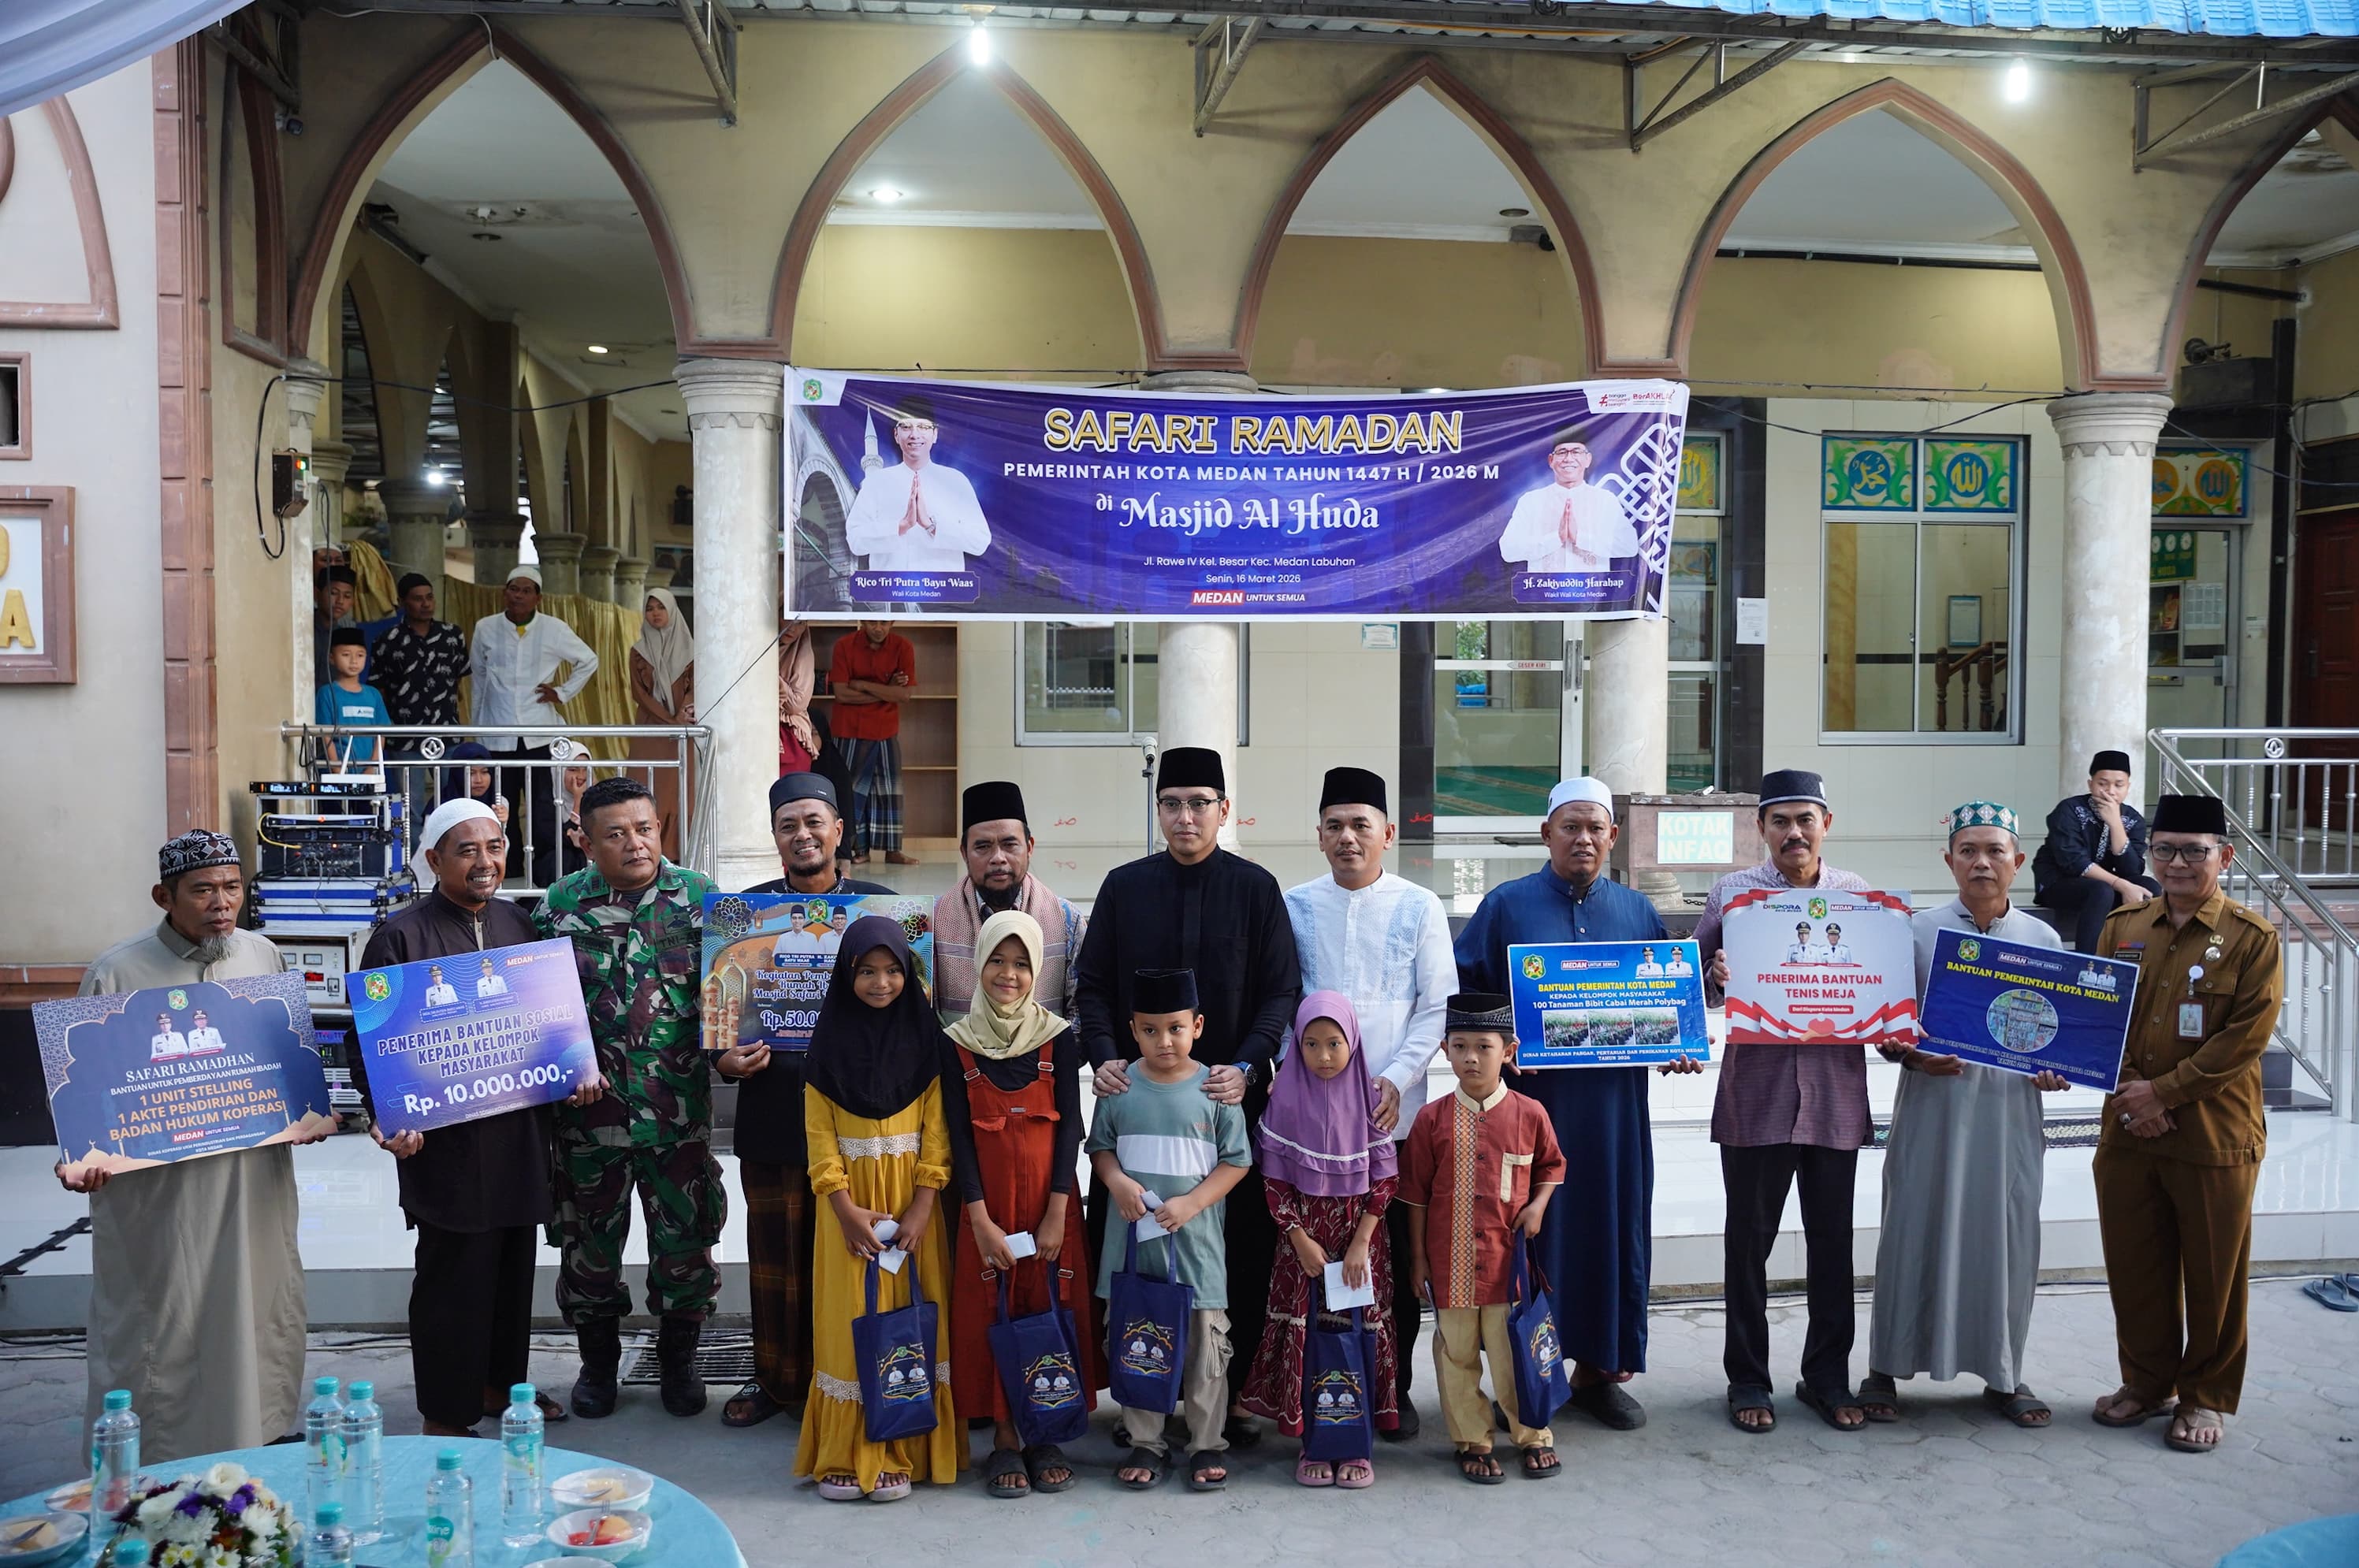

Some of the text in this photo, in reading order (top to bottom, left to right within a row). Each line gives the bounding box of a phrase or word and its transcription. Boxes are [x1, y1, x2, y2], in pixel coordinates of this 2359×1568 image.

[1044, 407, 1464, 455] SAFARI RAMADAN
[1004, 463, 1499, 483] PEMERINTAH KOTA MEDAN TAHUN 1447 H / 2026 M
[1096, 492, 1380, 536] di Masjid Al Huda
[1144, 557, 1356, 567] Jl. Rawe IV Kel. Besar Kec. Medan Labuhan
[855, 577, 973, 589] Rico Tri Putra Bayu Waas
[1206, 574, 1300, 584] Senin, 16 Maret 2026
[1524, 577, 1624, 589] H. Zakiyuddin Harahap
[1193, 592, 1243, 604] MEDAN
[1659, 816, 1730, 835] KOTAK
[507, 955, 533, 966] MEDAN
[2000, 954, 2028, 964] MEDAN
[756, 970, 802, 983] Kegiatan
[778, 980, 816, 990] Rumah
[1576, 982, 1624, 990] PEMERINTAH
[1758, 974, 1882, 984] PENERIMA BANTUAN
[1946, 961, 2120, 1002] BANTUAN PEMERINTAH KOTA MEDAN
[753, 988, 821, 1001] Masjid Safari
[1785, 989, 1856, 998] TENIS MEJA
[761, 1010, 784, 1031] Rp.
[378, 1005, 574, 1056] PENERIMA BANTUAN SOSIAL
[417, 1027, 541, 1066] KEPADA KELOMPOK
[126, 1065, 175, 1083] SAFARI
[178, 1052, 255, 1073] RAMADHAN
[440, 1047, 526, 1079] MASYARAKAT
[110, 1062, 282, 1095] BANTUAN UNTUK PEMBERDAYAAN RUMAH IBADAH
[140, 1078, 253, 1105] 1 UNIT STELLING
[404, 1063, 575, 1116] Rp. 10.000.000,-
[118, 1088, 277, 1124] 1 AKTE PENDIRIAN DAN
[110, 1101, 287, 1141] BADAN HUKUM KOPERASI
[173, 1131, 204, 1143] MEDAN
